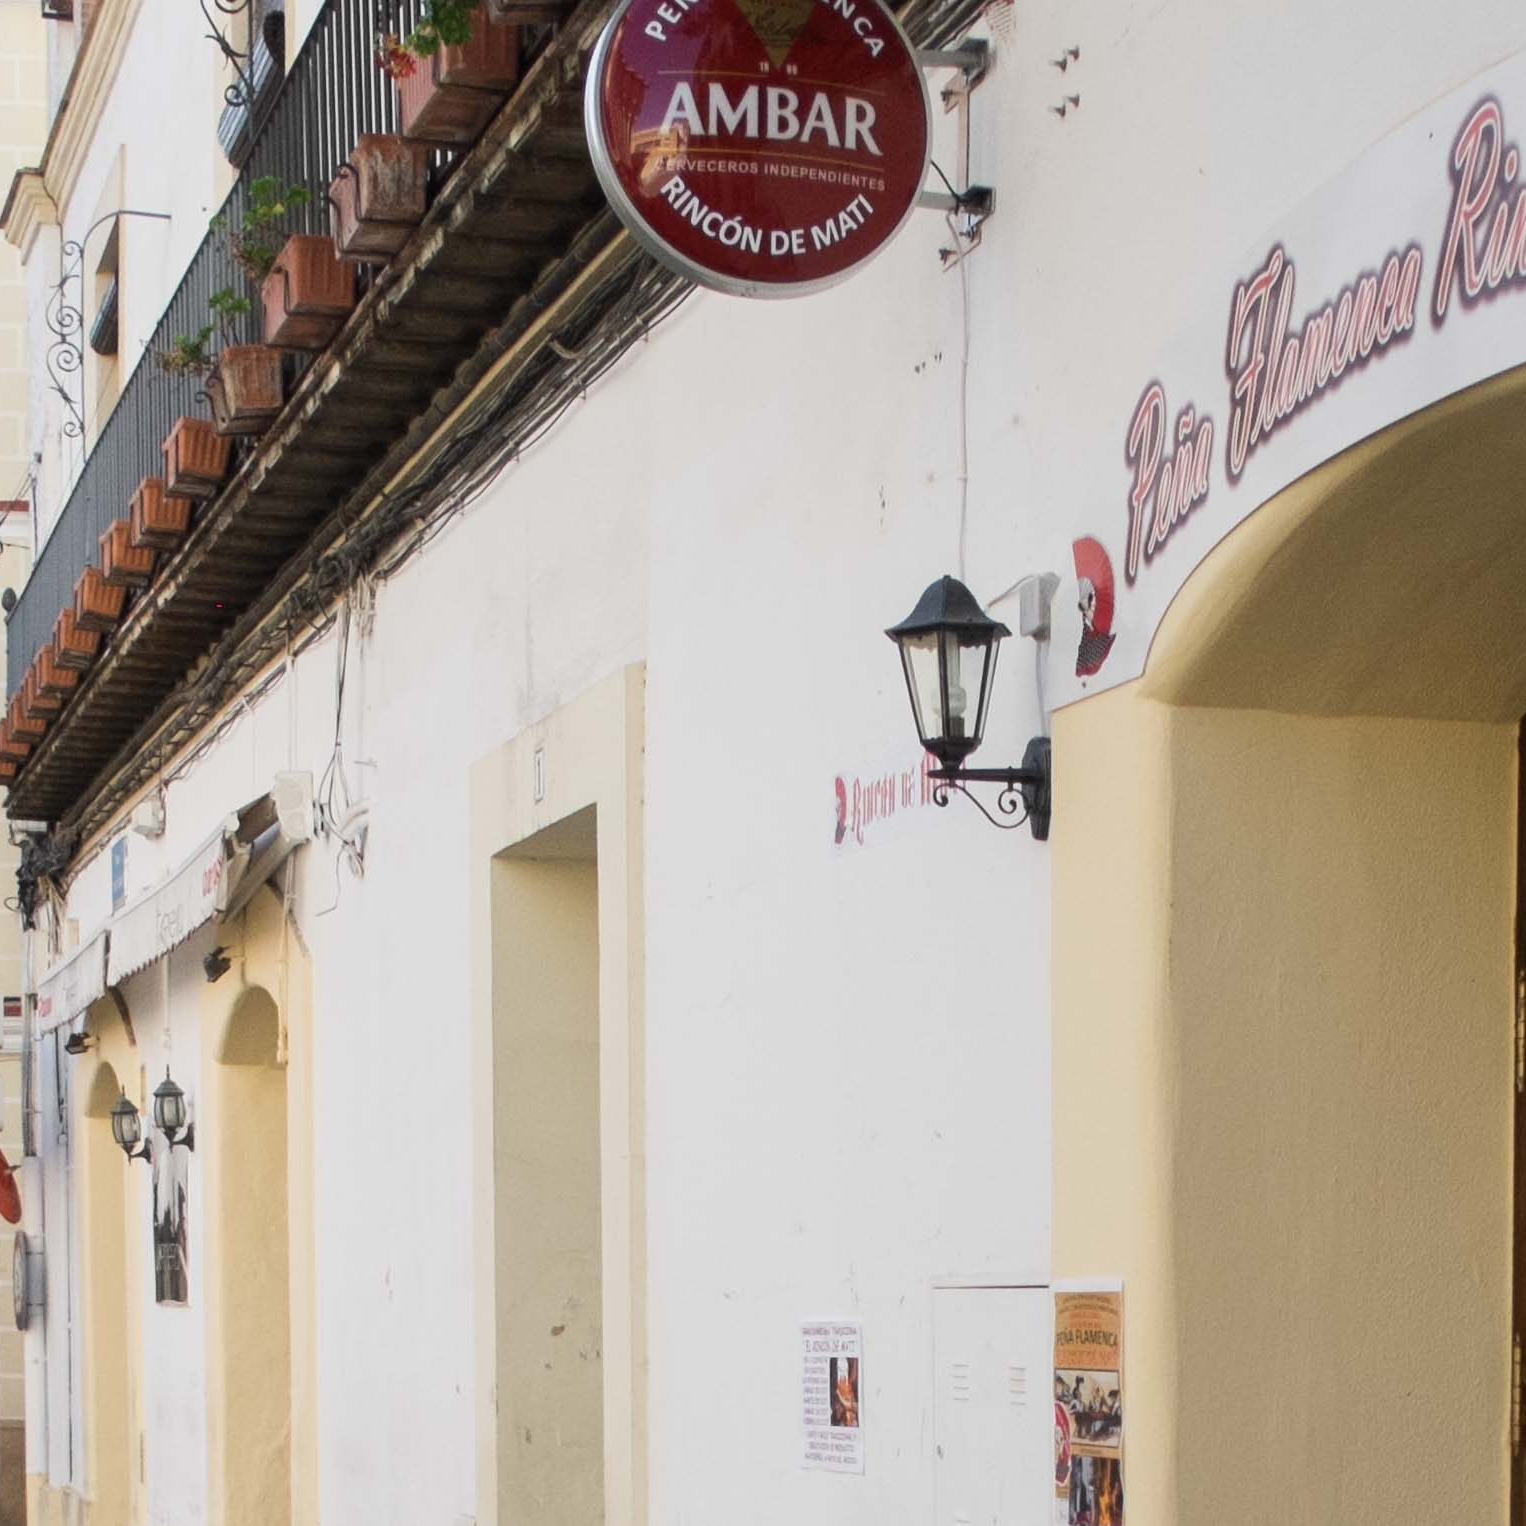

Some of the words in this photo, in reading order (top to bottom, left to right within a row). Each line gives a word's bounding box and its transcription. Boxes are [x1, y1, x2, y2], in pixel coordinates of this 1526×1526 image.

[658, 81, 884, 156] AMBAR
[656, 158, 759, 175] CERVECEROS
[763, 163, 886, 191] INDEPENDIENTES
[659, 175, 763, 254] RINCÓN
[769, 229, 807, 256] DE
[811, 192, 876, 251] MATI
[1126, 380, 1214, 588] Peña
[1225, 244, 1423, 488] Flamenca
